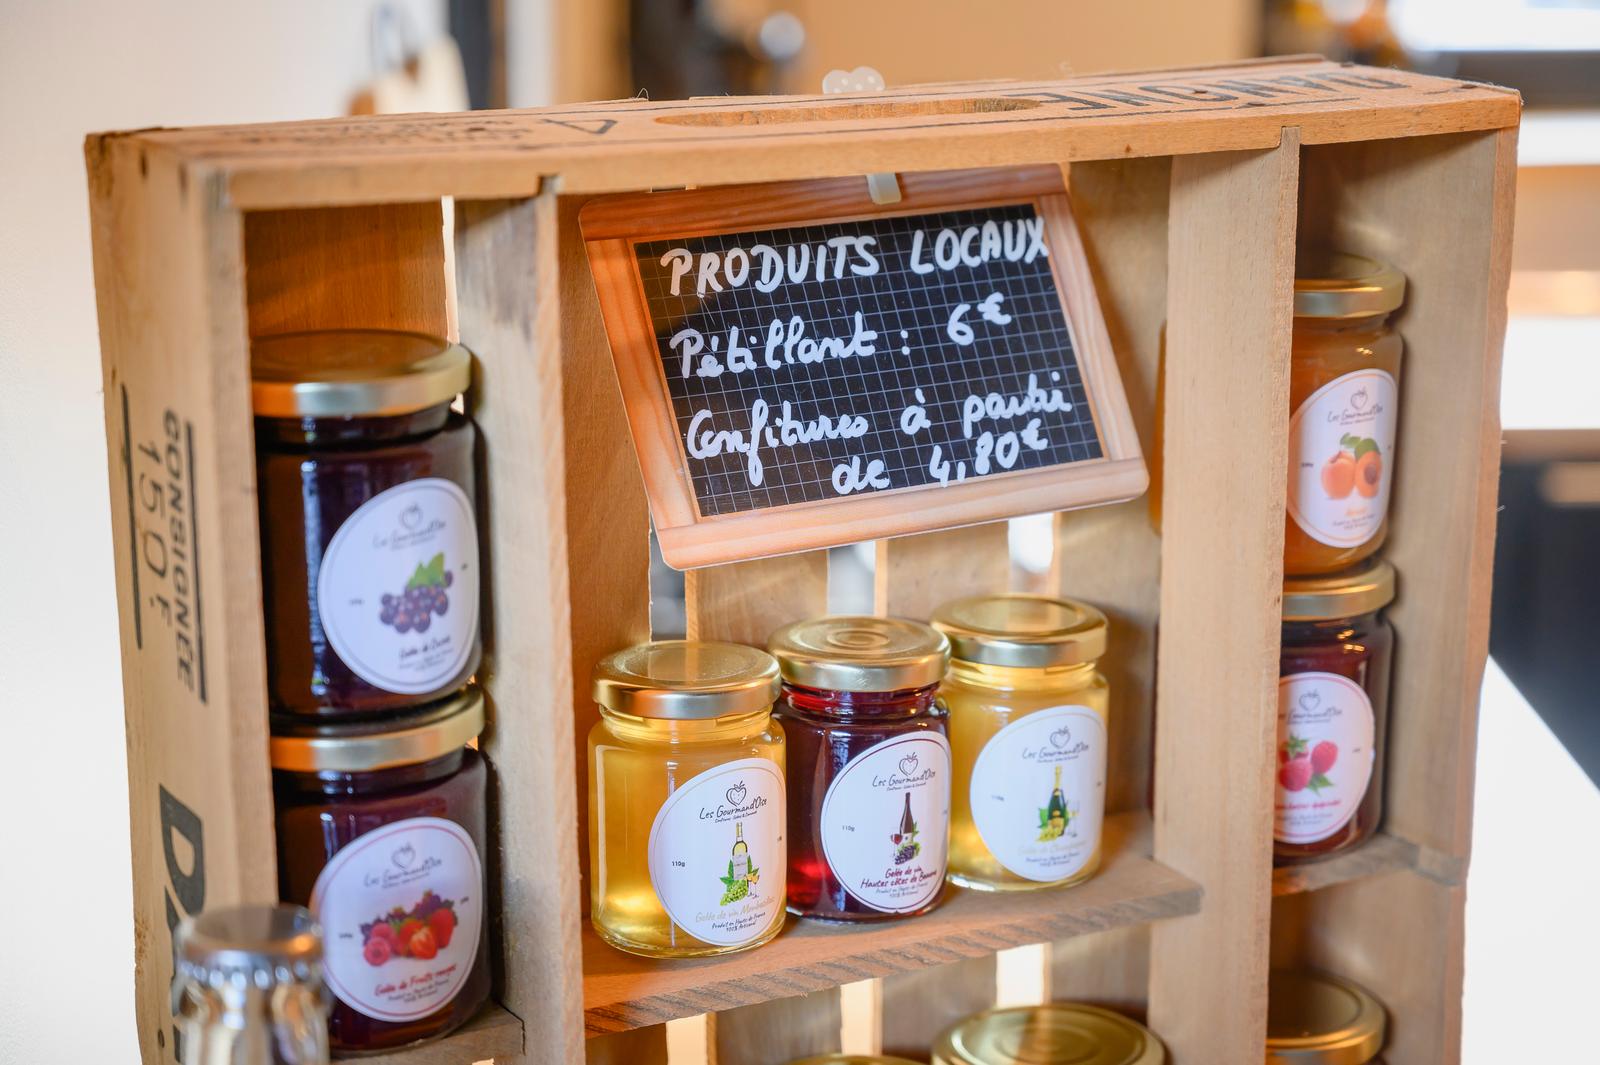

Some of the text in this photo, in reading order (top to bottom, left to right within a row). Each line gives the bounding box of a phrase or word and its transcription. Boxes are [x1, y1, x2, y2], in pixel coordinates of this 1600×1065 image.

[660, 216, 1049, 298] PRODUITS LOCAUX
[669, 311, 878, 378] Pétillant
[687, 399, 869, 487] Confitures
[900, 388, 931, 435] à
[832, 418, 1048, 494] de 4,80€
[138, 440, 168, 578] 150
[162, 408, 196, 694] CONSIGNÉE
[699, 807, 714, 820] Les
[872, 775, 887, 787] Les
[860, 878, 889, 889] Hautes
